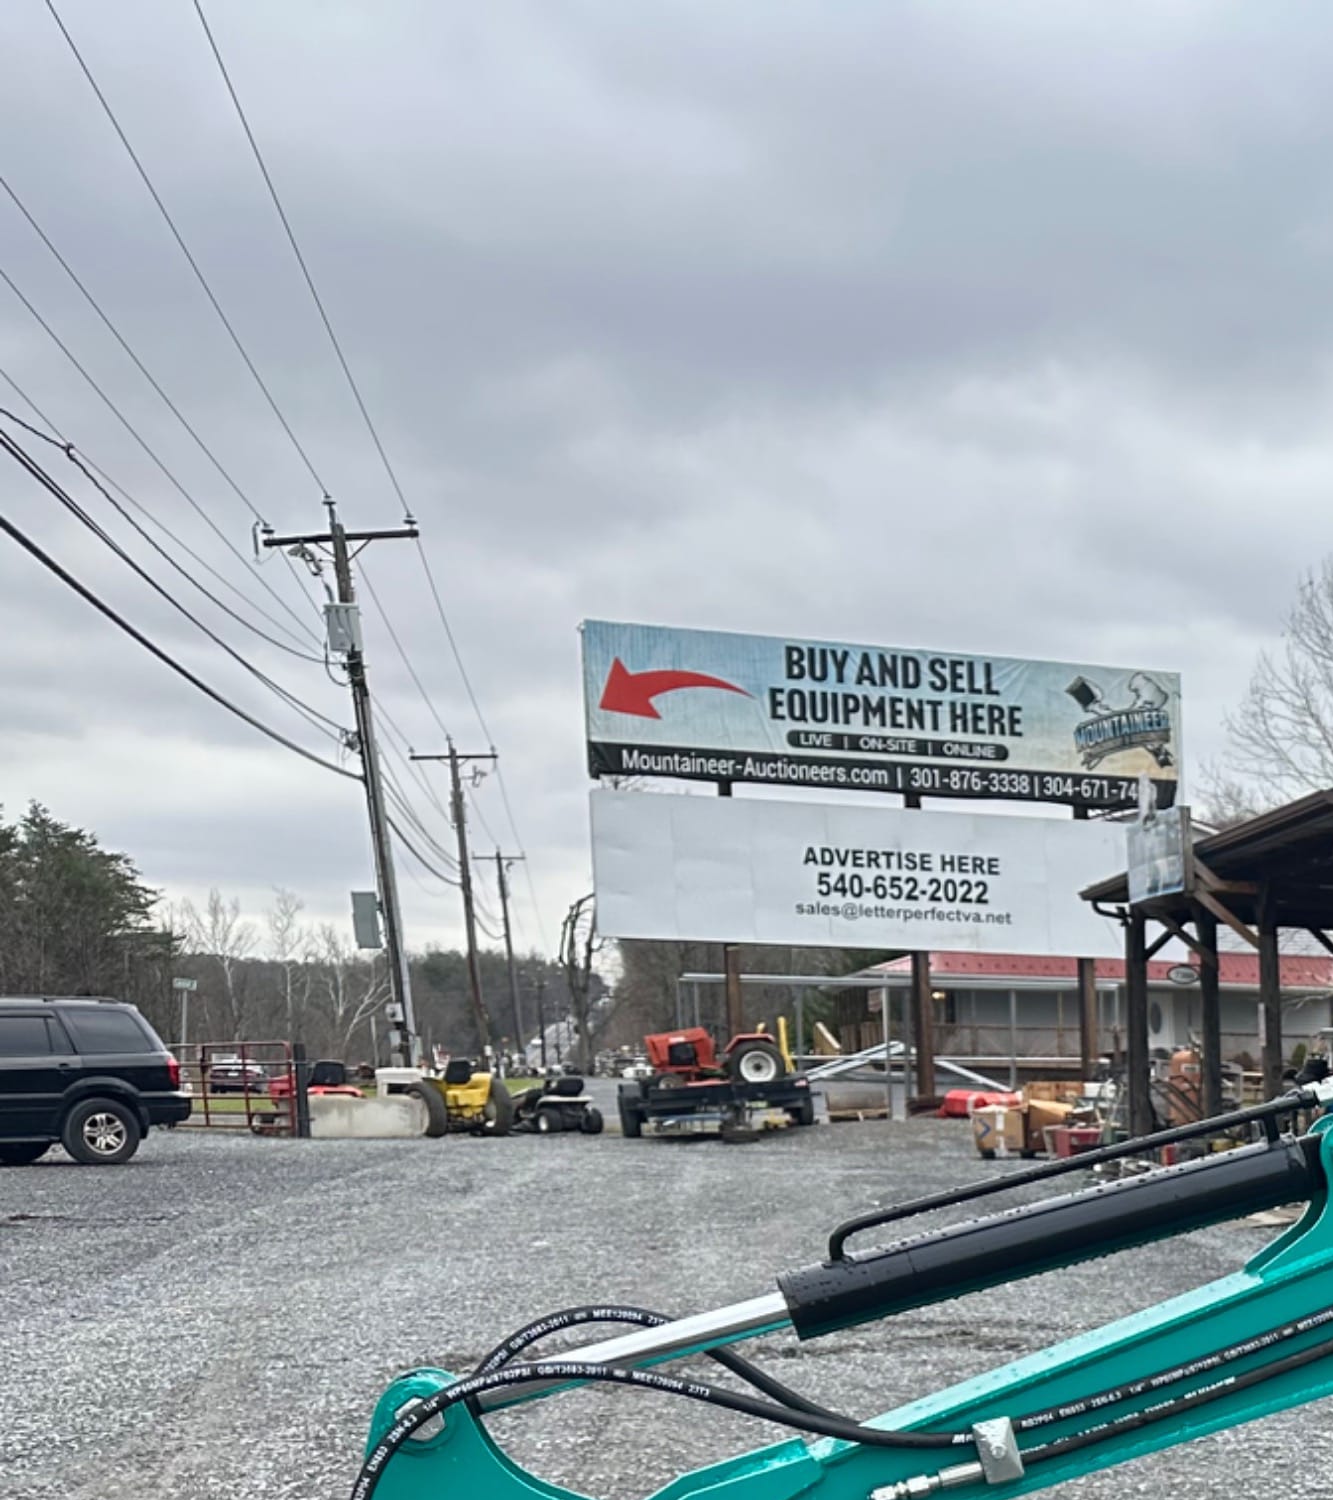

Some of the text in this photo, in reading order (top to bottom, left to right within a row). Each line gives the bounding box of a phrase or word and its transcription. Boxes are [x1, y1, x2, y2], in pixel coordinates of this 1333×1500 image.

[784, 646, 1000, 696] BUY AND SELL
[768, 687, 1023, 737] EQUIPMENT HERE
[800, 733, 996, 759] LIVE ON-SITE ONLINE
[621, 749, 1156, 801] Mountaineer-Auctioneers.com 301-876-3338 304-671-74
[803, 846, 1001, 876] ADVERTISE HERE
[816, 871, 990, 905] 540-652-2022
[795, 901, 1013, 925] sales@letterperfectva.net
